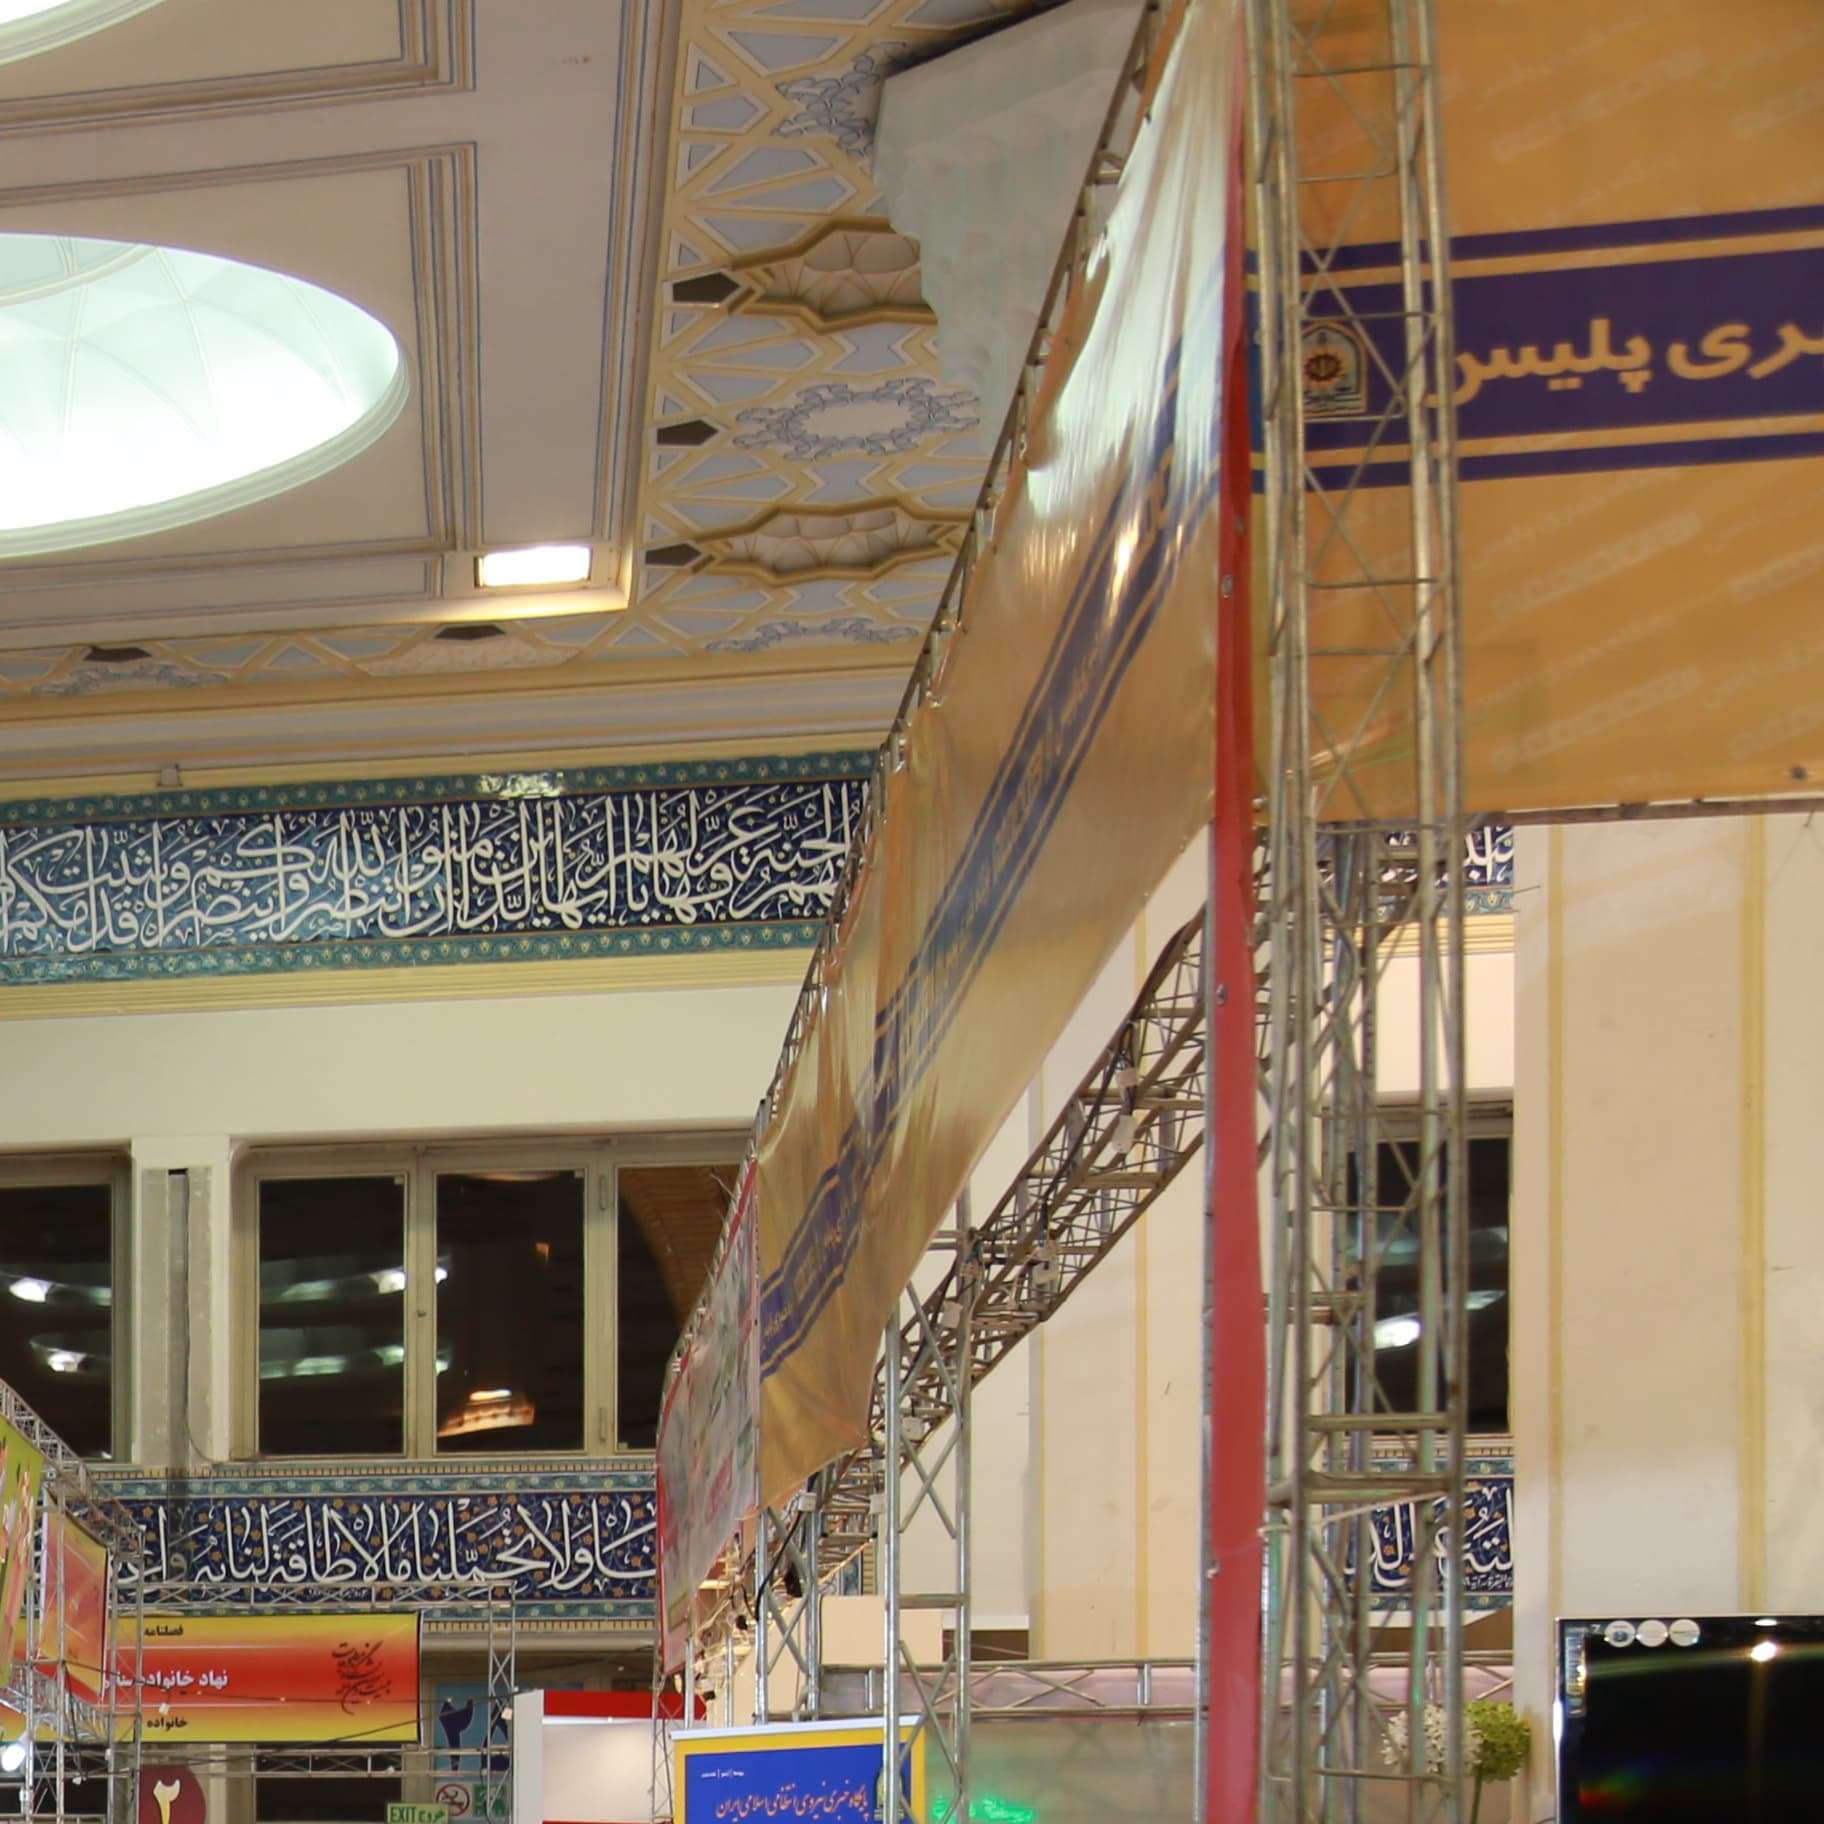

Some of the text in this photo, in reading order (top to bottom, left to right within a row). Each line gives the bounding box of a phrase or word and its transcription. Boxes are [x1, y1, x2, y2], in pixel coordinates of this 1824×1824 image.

[1424, 317, 1651, 408] پلیس
[144, 1624, 184, 1637] فصلنامه
[198, 1669, 229, 1690] نهاد
[146, 1717, 189, 1732] خانواده
[389, 1806, 416, 1824] EXIT
[418, 1807, 446, 1824] خروج
